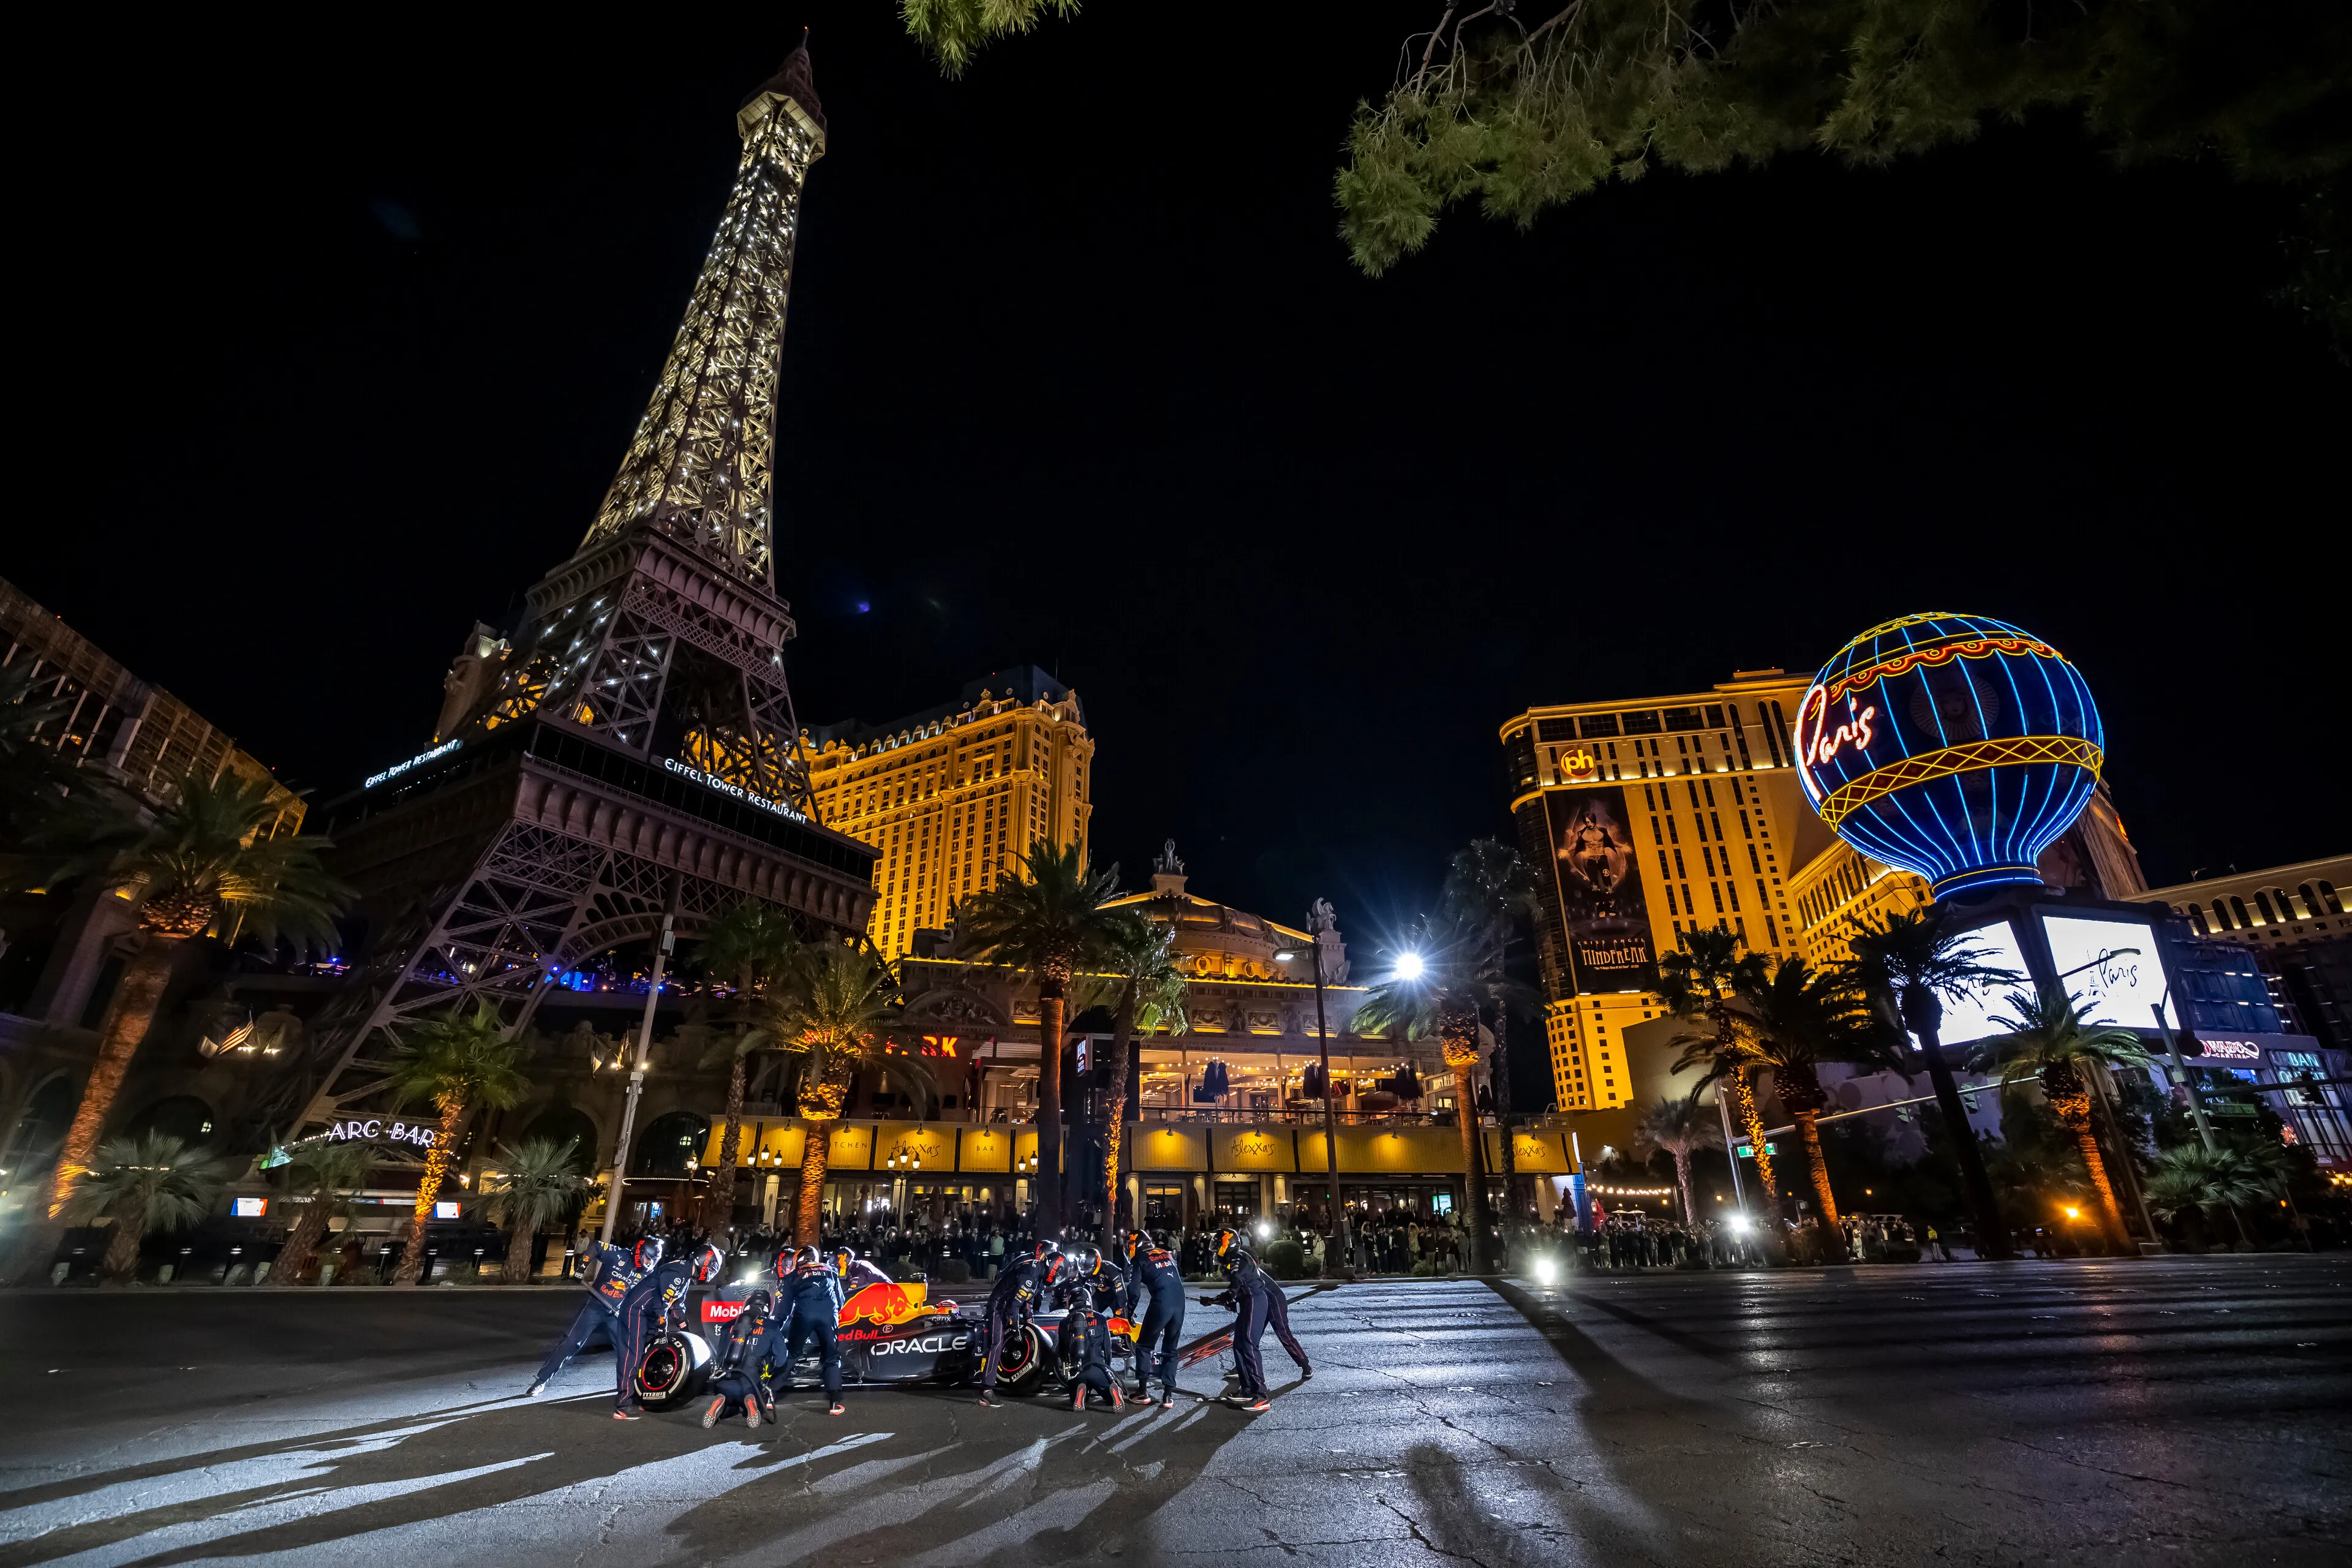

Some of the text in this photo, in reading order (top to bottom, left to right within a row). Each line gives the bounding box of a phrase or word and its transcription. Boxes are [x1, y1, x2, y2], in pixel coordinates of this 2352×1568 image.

[1795, 684, 1875, 801] Paris
[366, 739, 458, 788] EIFFEL TOWER RESTAURANT
[1565, 749, 1594, 773] ph
[665, 758, 807, 824] EIFFEL TOWER RESTAURANT
[2098, 948, 2138, 988] Paris
[329, 1120, 434, 1148] ARC BAR
[838, 1329, 878, 1341] ed Bull
[870, 1336, 968, 1356] ORACLE
[643, 1391, 666, 1400] PIRELLI
